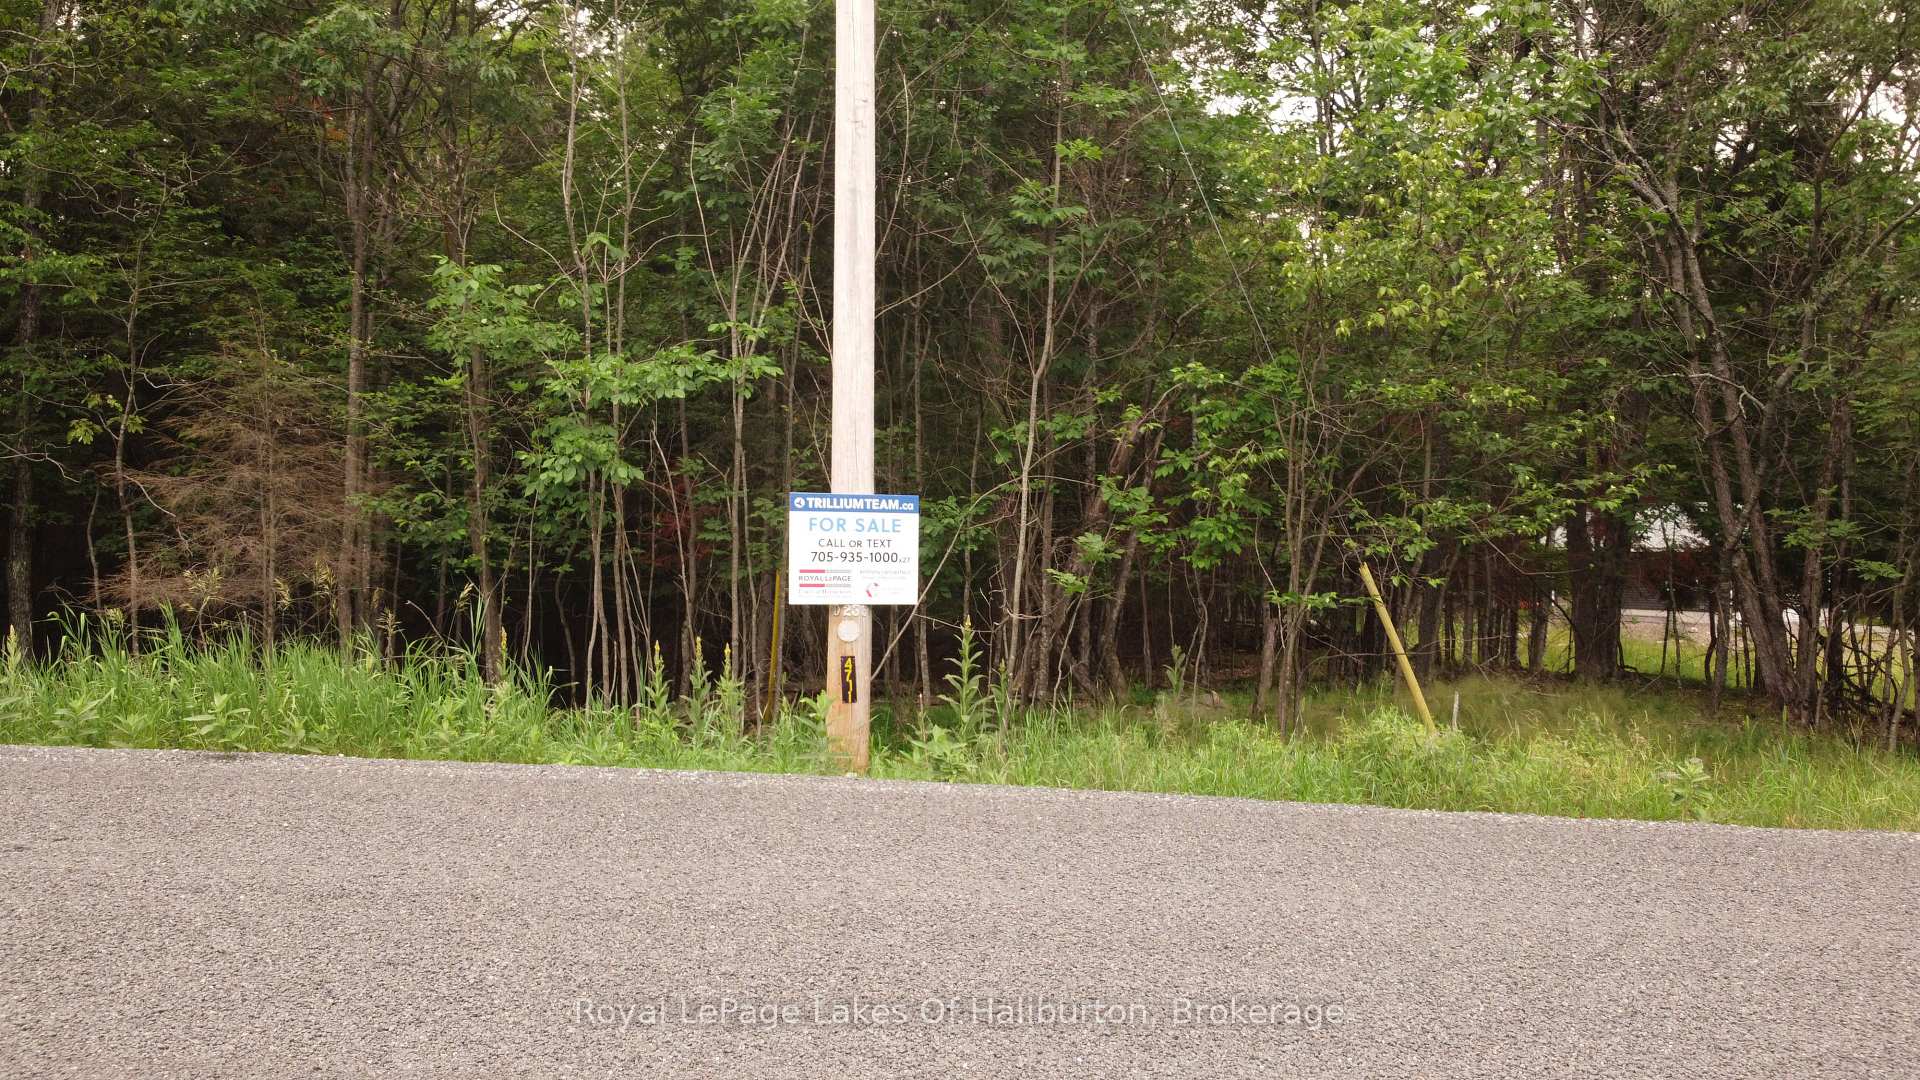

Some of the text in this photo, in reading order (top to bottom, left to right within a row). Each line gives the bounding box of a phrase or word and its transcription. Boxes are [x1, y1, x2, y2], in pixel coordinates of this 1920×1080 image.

[808, 517, 902, 533] FOR SALE
[818, 539, 892, 548] CALL OR TEXT
[811, 551, 898, 563] 705-935-1000
